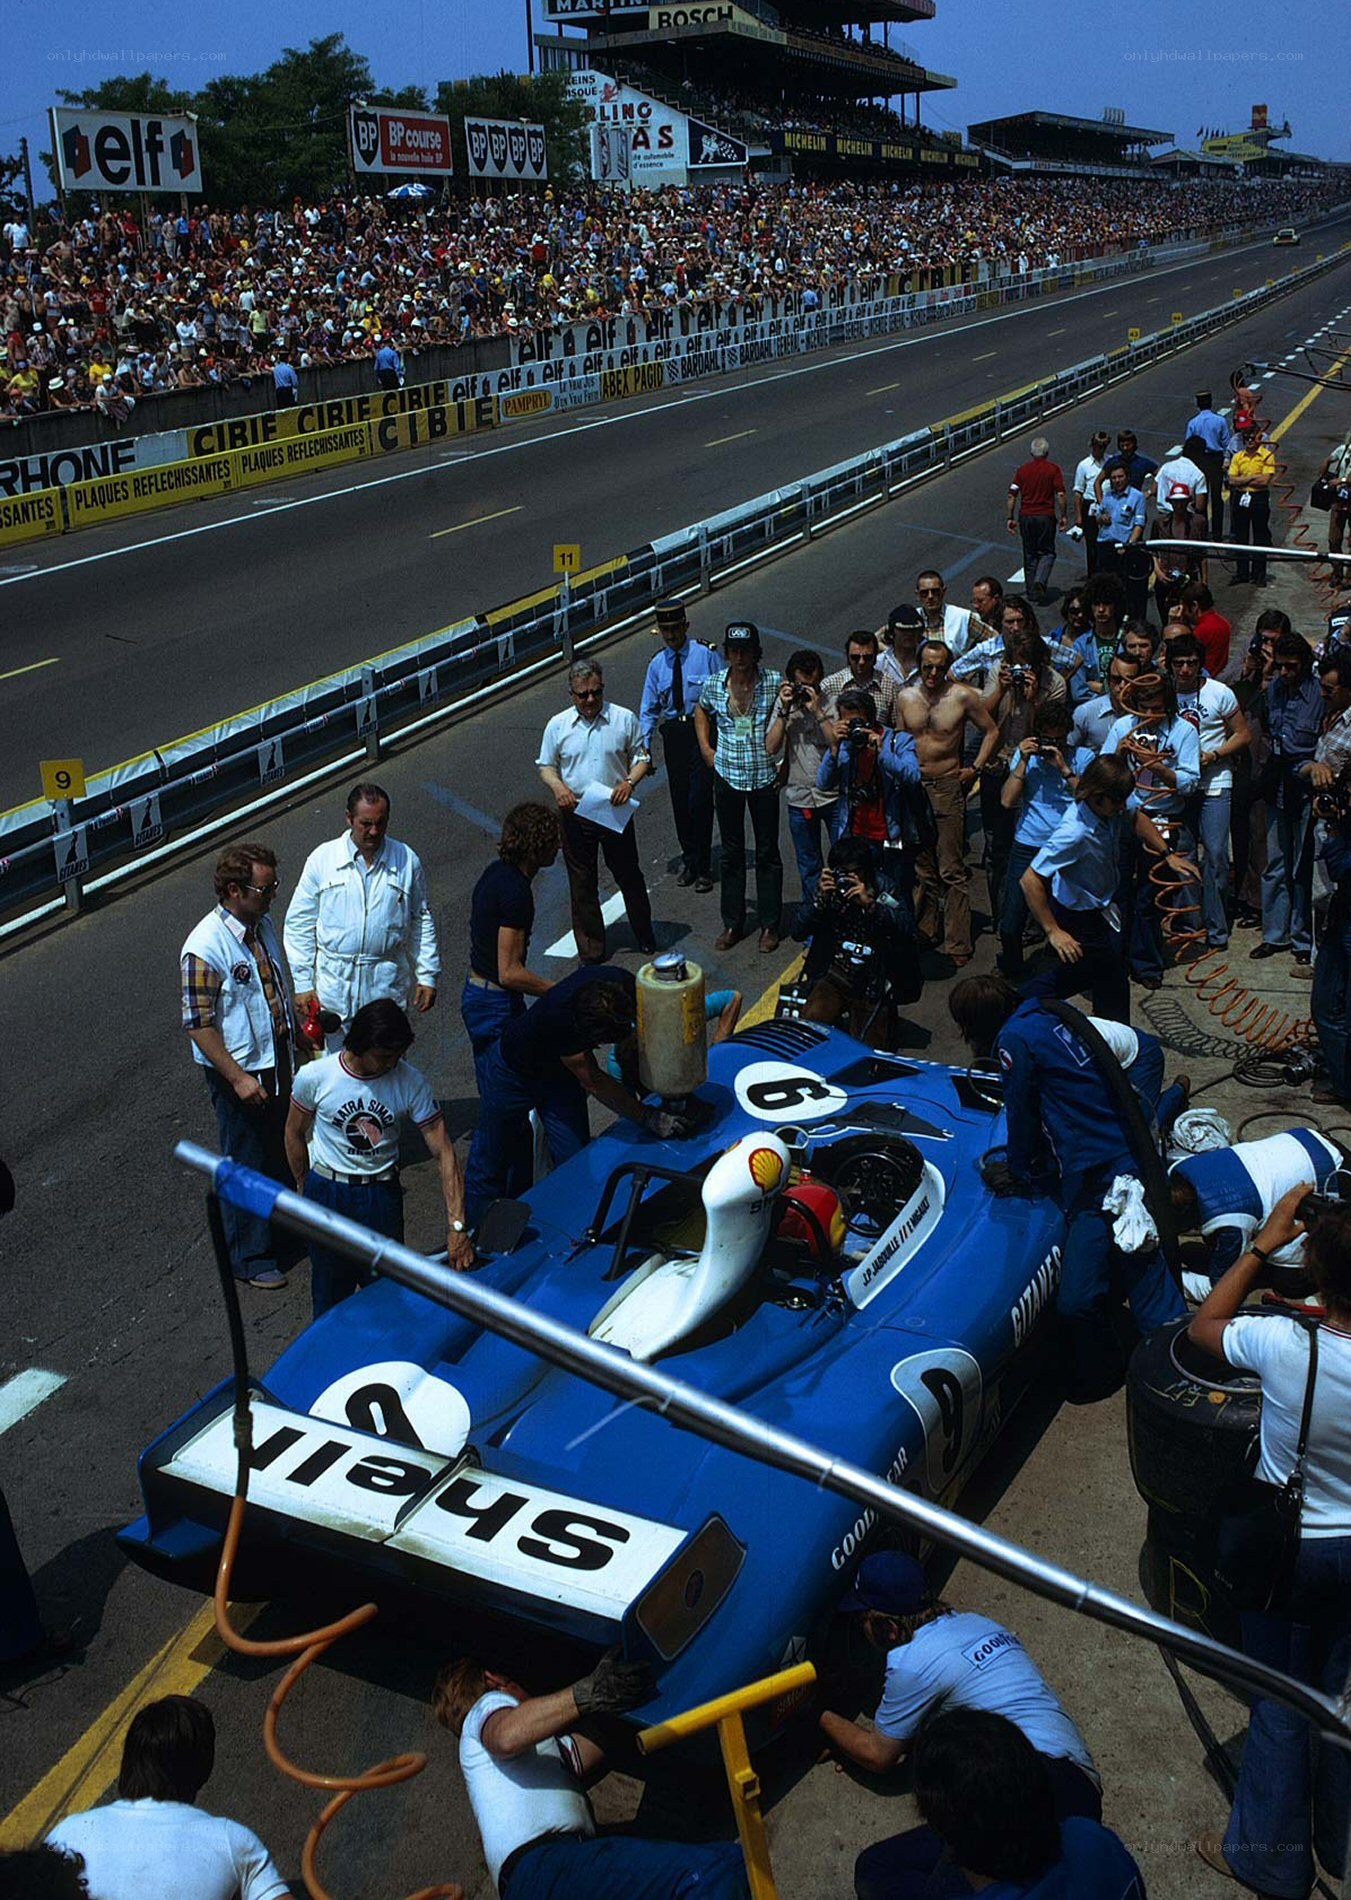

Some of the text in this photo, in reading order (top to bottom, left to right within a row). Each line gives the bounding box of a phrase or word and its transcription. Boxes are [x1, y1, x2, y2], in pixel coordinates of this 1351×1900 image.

[657, 5, 734, 30] BOSCH
[94, 118, 165, 186] elf
[357, 120, 378, 151] BP
[388, 121, 443, 150] BP course
[471, 131, 544, 163] BP BP BP BP
[784, 131, 828, 151] MICHELIN
[836, 137, 873, 156] MICHELIN
[586, 315, 617, 353] elf
[453, 376, 478, 402] elf
[498, 368, 521, 392] elf
[543, 359, 564, 383] elf
[583, 353, 603, 375] elf
[621, 346, 639, 368] elf
[655, 340, 672, 361] elf
[687, 334, 702, 355] elf
[602, 362, 664, 399] ABEX PAGID
[681, 350, 720, 379] BARDAHL
[297, 396, 372, 434] CIBIE
[382, 382, 446, 417] CIBIE
[193, 413, 278, 458] CIBIE
[378, 395, 495, 451] CIBIE
[241, 427, 365, 474] PLAQUES REFLECHISSANTES
[0, 439, 136, 498] RHONE
[74, 458, 231, 511] PLAQUES REFLECHISSANTES
[0, 496, 54, 529] SANTES
[559, 552, 574, 567] 11
[55, 770, 72, 790] 9
[135, 823, 162, 846] GITANES
[59, 857, 89, 878] GITANES
[331, 1097, 395, 1130] MATRA SIMCA
[1010, 1244, 1063, 1349] GITANES
[831, 1445, 909, 1571] GOODEAR
